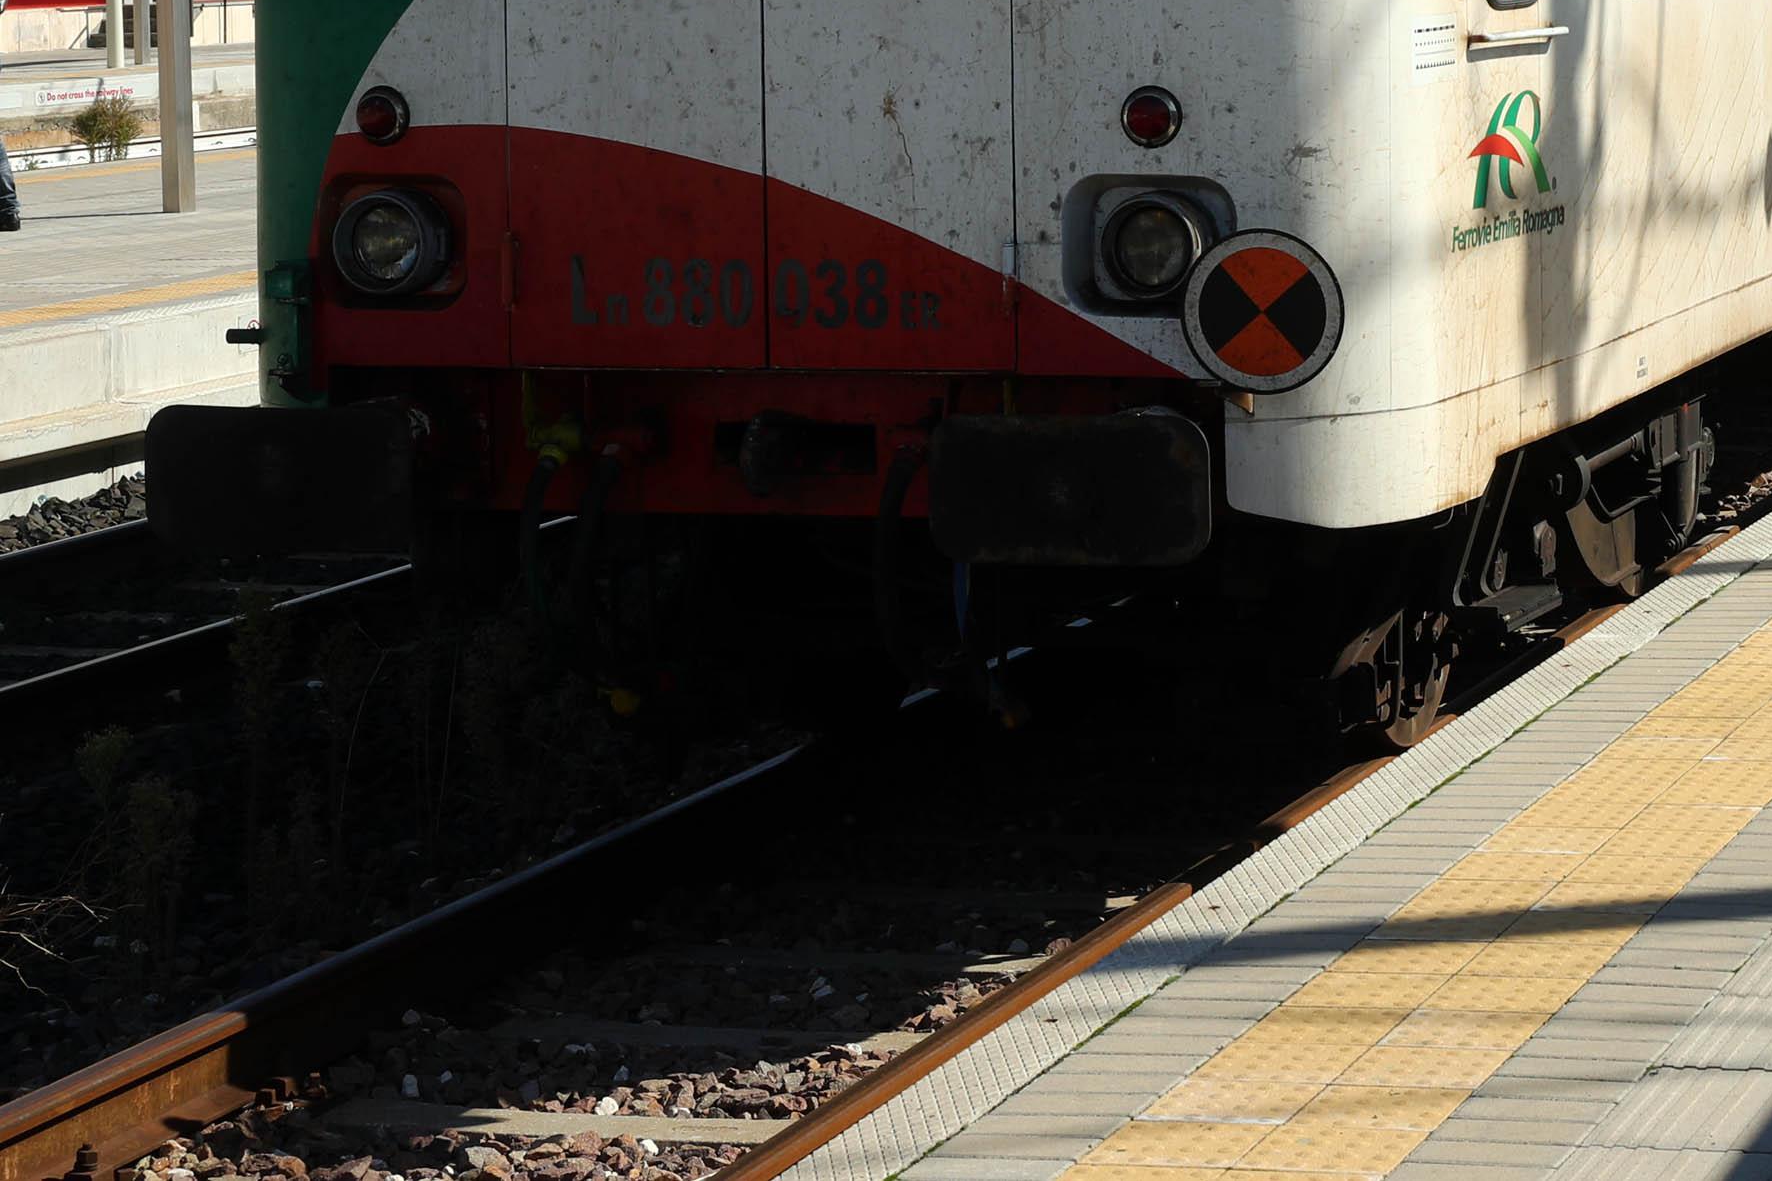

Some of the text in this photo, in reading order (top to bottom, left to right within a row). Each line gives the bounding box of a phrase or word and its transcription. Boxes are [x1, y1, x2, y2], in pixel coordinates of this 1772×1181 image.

[47, 92, 56, 101] Do
[57, 92, 67, 100] not
[69, 91, 84, 99] cross
[85, 89, 95, 98] the
[1451, 204, 1565, 253] Ferrovie Emilia Romagna
[641, 257, 754, 330] 880
[774, 257, 890, 330] 038
[901, 289, 943, 331] ER
